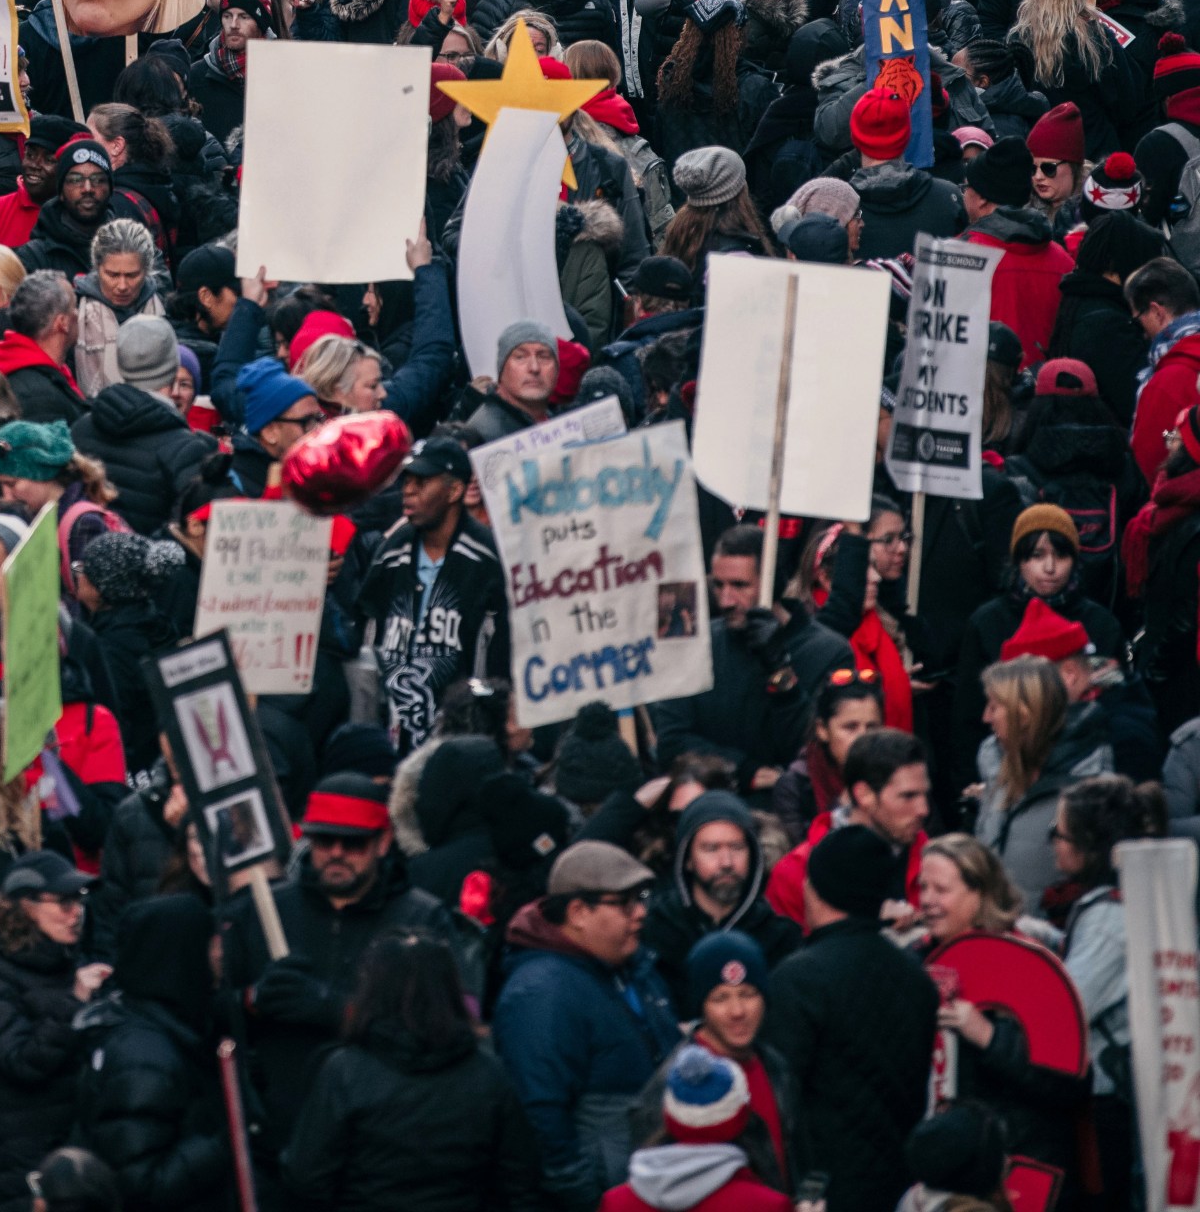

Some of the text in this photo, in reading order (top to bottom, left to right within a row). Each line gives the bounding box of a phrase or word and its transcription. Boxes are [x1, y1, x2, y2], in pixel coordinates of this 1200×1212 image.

[506, 436, 686, 541] Nobody
[544, 516, 596, 545] puts
[510, 545, 663, 609] Education
[570, 596, 618, 634] the
[523, 636, 655, 702] Corner
